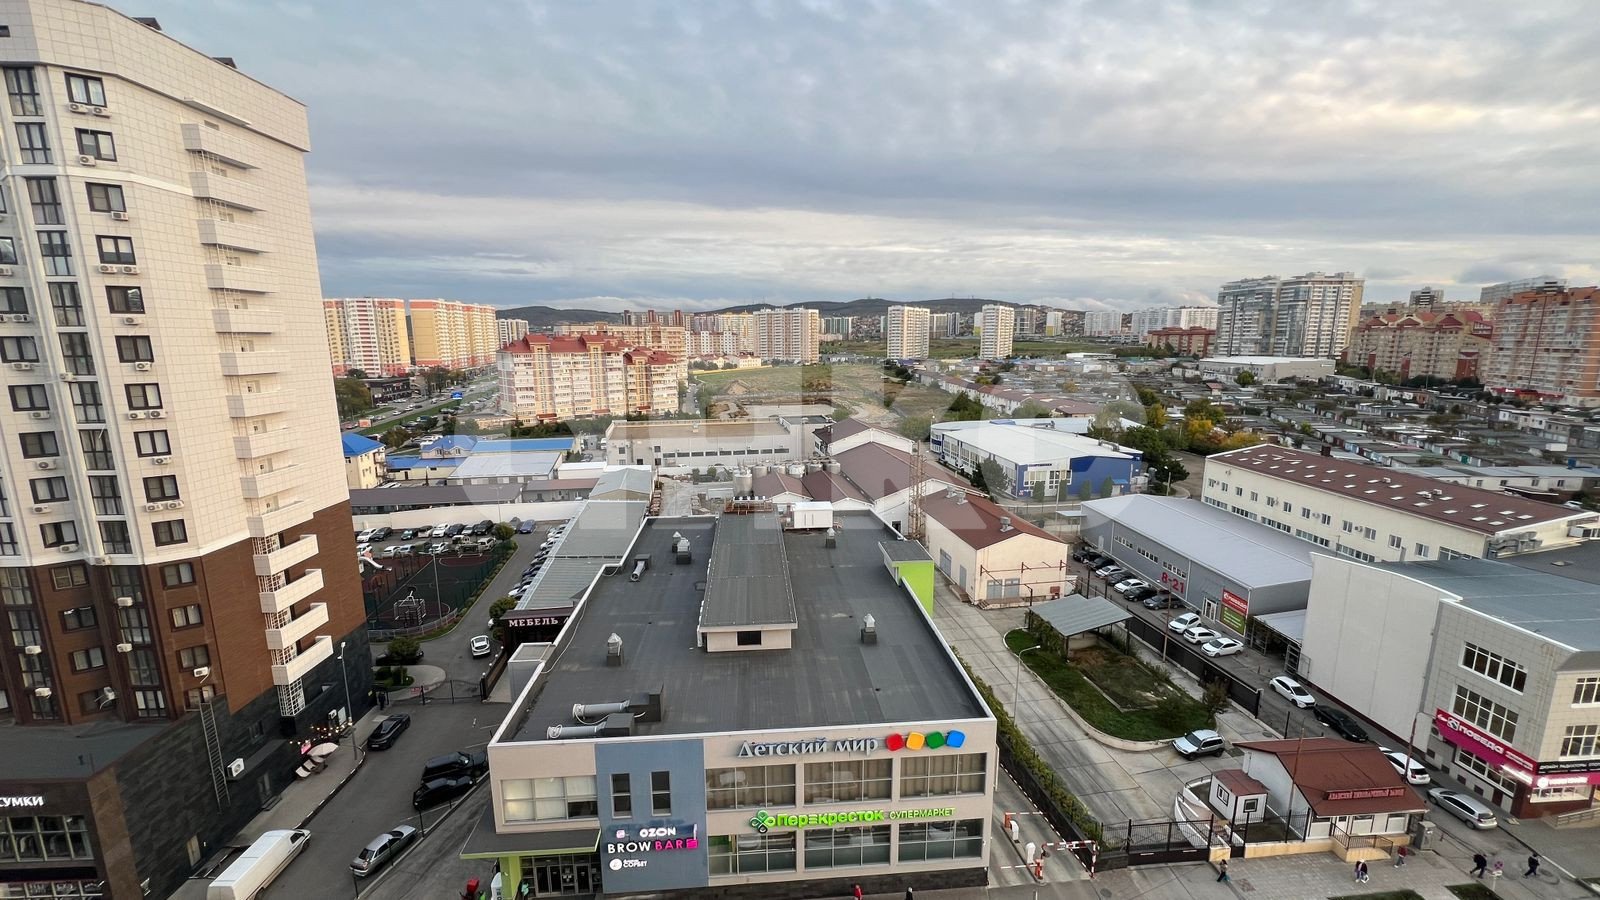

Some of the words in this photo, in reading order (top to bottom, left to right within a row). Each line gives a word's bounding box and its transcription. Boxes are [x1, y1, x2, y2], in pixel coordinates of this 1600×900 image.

[1161, 572, 1185, 594] 8-21
[508, 617, 558, 627] МЕБЕЛЬ
[737, 737, 827, 758] Детский
[834, 736, 879, 756] мир
[889, 807, 956, 820] СУПЕРМАРКЕТ
[640, 827, 676, 837] OZON
[608, 842, 651, 853] BROW
[655, 839, 684, 851] BAR
